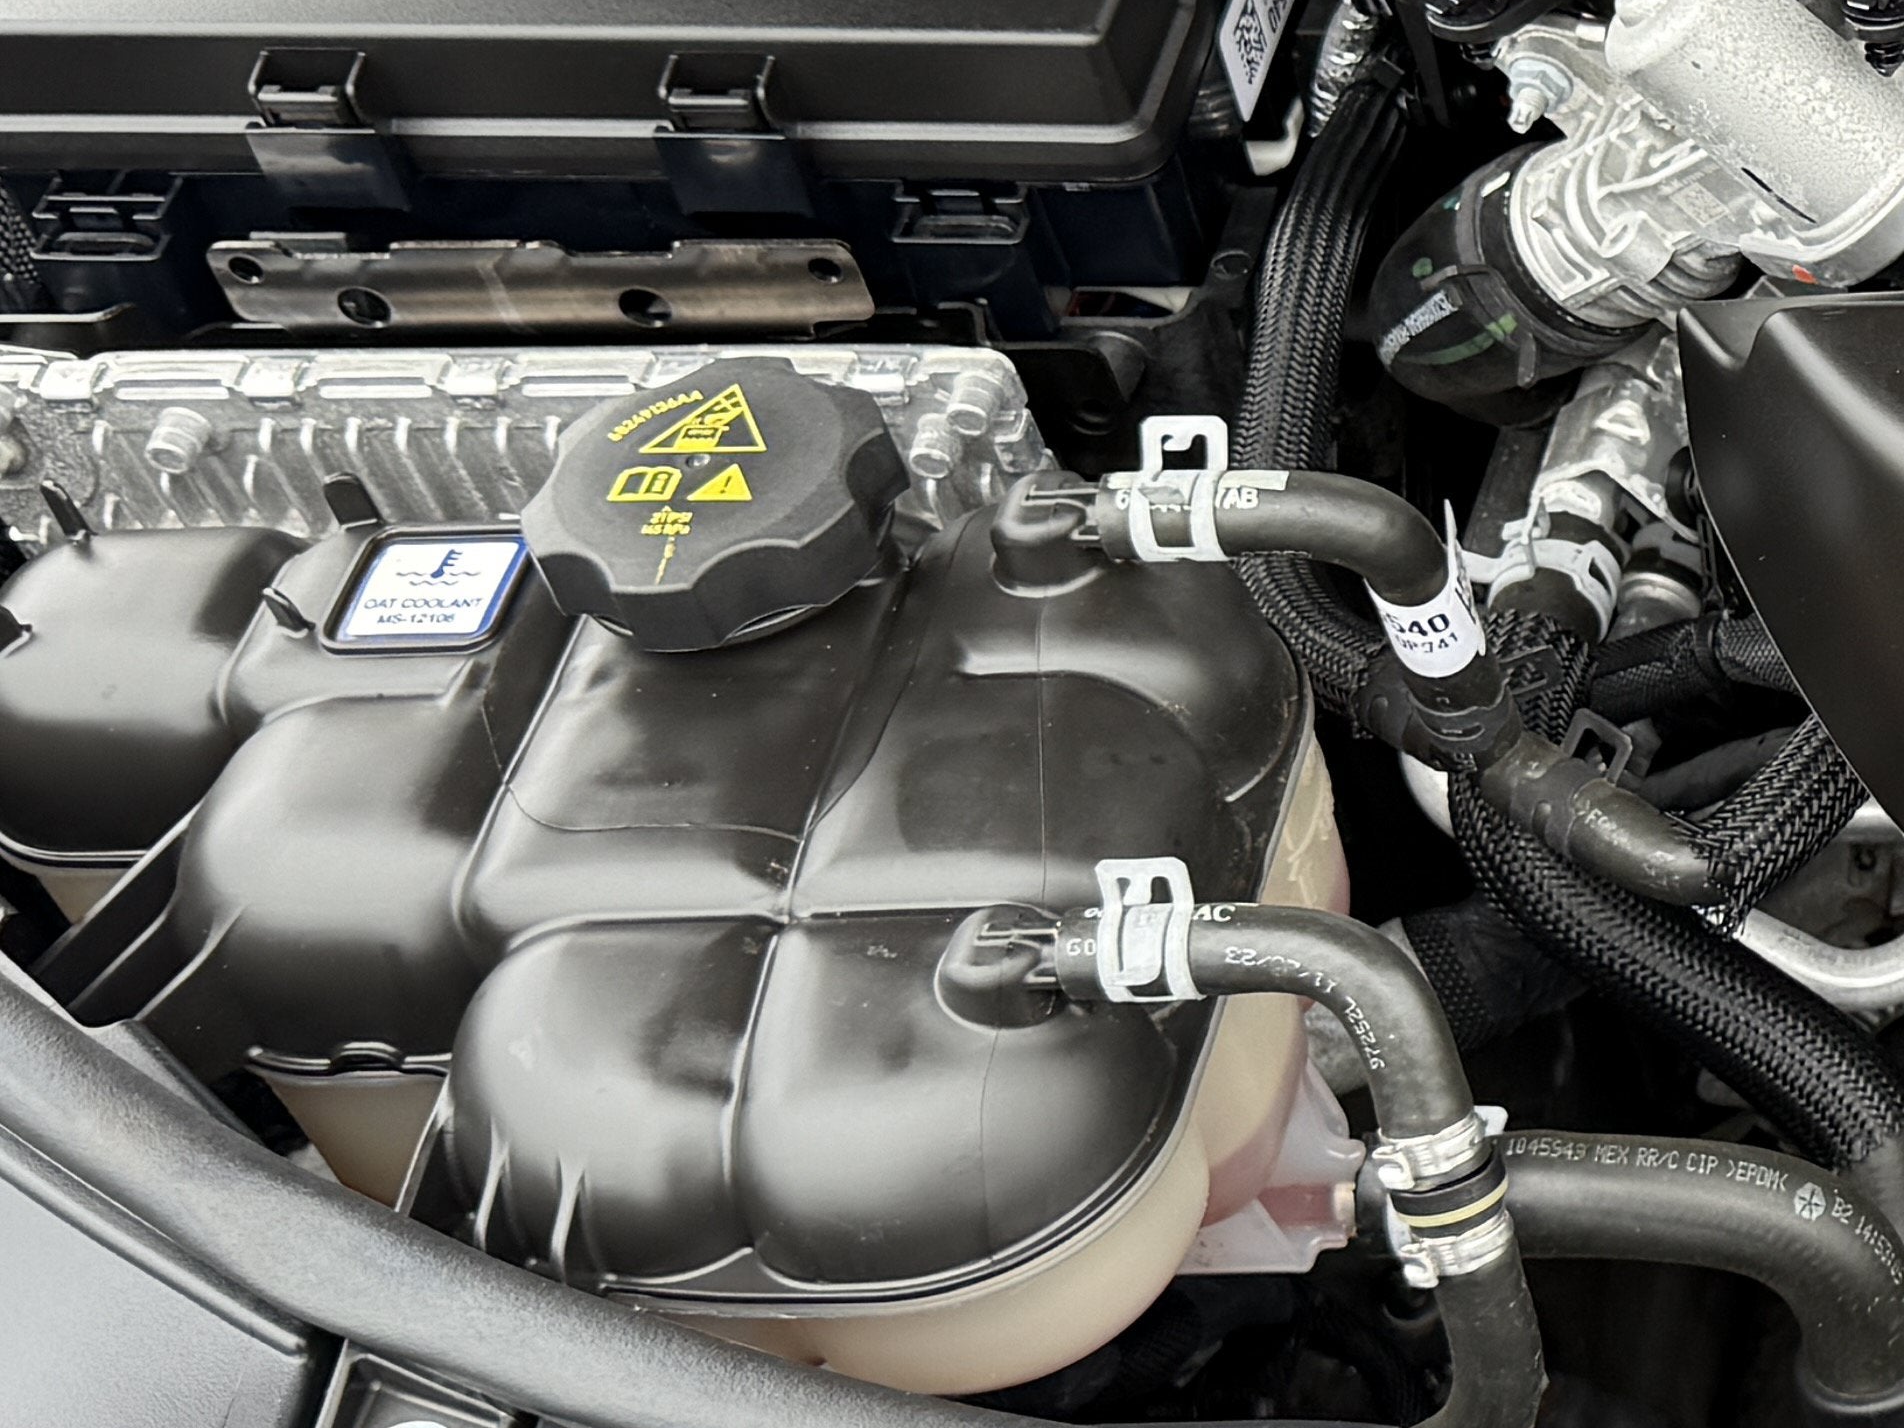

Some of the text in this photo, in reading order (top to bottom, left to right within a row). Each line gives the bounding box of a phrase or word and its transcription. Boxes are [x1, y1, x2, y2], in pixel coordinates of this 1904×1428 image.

[363, 596, 484, 610] OAT COOLANT
[1593, 1143, 1630, 1165] MEX
[1636, 1145, 1679, 1170] RR/C
[1686, 1153, 1720, 1175] CIP
